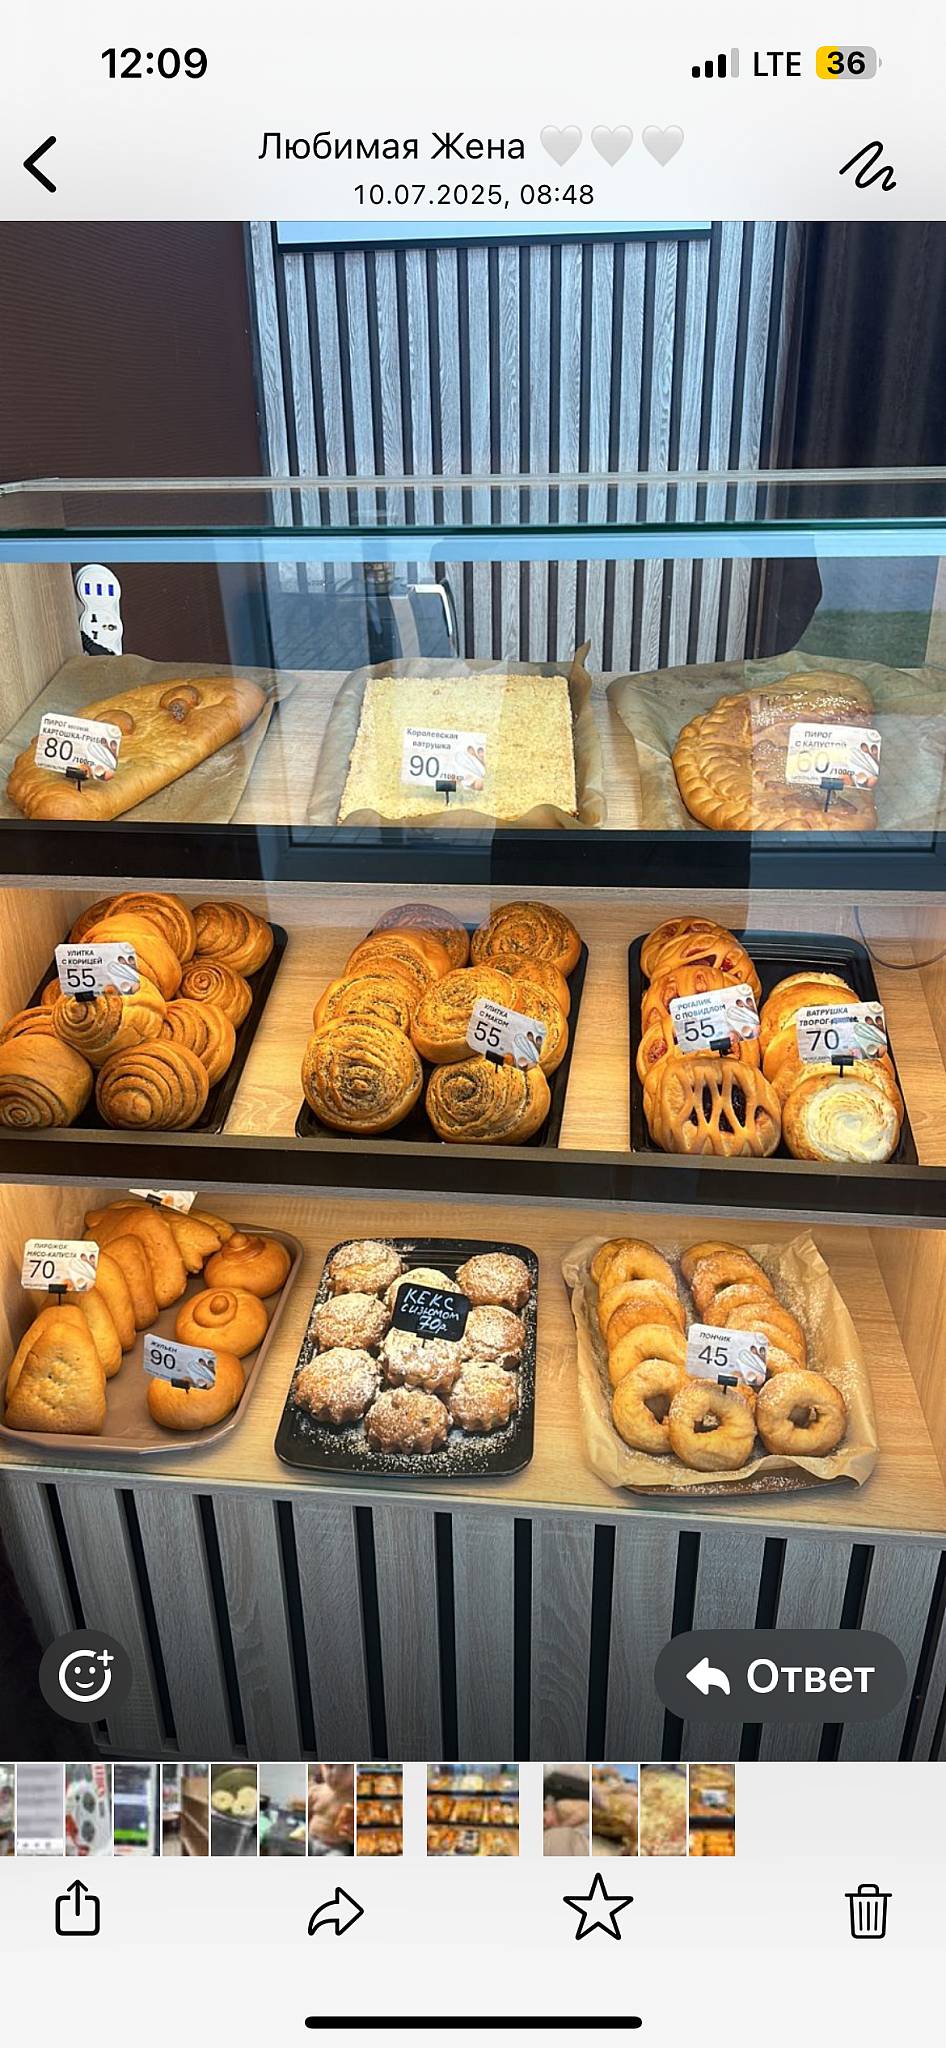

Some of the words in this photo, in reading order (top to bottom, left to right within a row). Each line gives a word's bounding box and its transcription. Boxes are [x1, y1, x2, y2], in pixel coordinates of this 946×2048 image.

[406, 728, 459, 740] Королевская
[804, 731, 832, 740] ПИРОГ
[44, 737, 73, 761] 80
[412, 740, 451, 750] ватрушка
[409, 755, 440, 779] 90
[68, 957, 103, 965] КОРИЦЕЙ
[67, 968, 96, 988] 55
[484, 1003, 508, 1019] УЛИТКА
[677, 998, 712, 1011] РОГАЛИК
[682, 1004, 726, 1019] ПОВИДЛОМ
[806, 1007, 849, 1017] ВАТРУШКА
[485, 1012, 509, 1027] МАКОМ
[473, 1020, 502, 1048] 55
[684, 1017, 716, 1042] 55
[806, 1029, 840, 1051] 70
[29, 1259, 55, 1279] 70
[403, 1288, 454, 1311] КЕКС
[699, 1332, 732, 1342] ПОНЧИК
[150, 1349, 176, 1370] 90
[698, 1345, 729, 1367] 45
